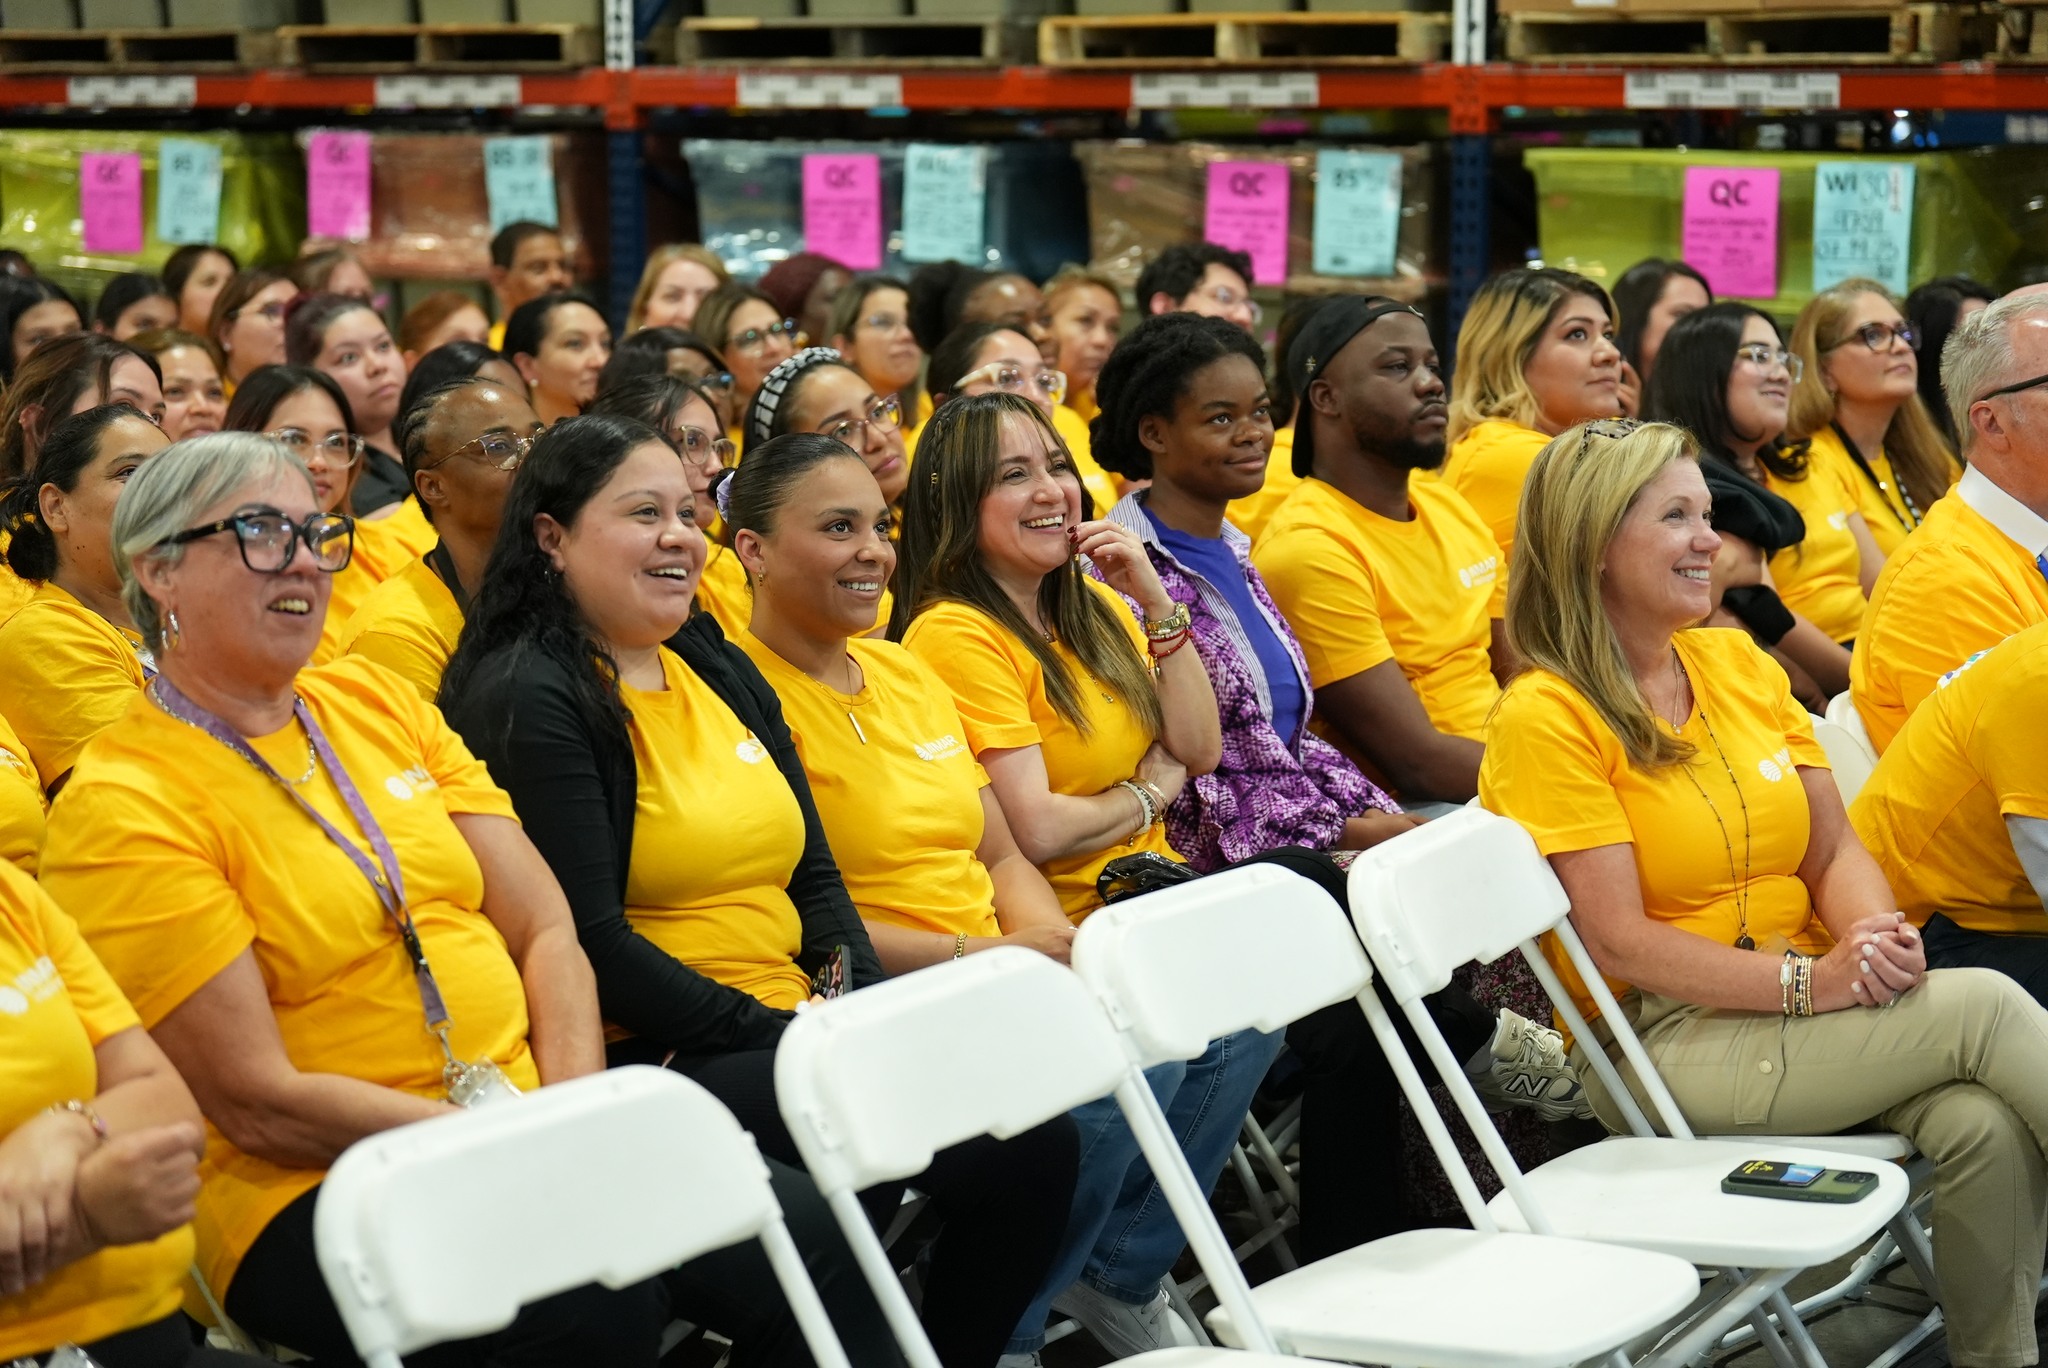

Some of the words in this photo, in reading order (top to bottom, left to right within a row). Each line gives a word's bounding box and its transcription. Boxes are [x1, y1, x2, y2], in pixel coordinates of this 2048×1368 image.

[823, 164, 856, 189] QC
[1229, 171, 1265, 197] QC
[1709, 179, 1750, 208] QC
[1505, 1072, 1552, 1098] N
